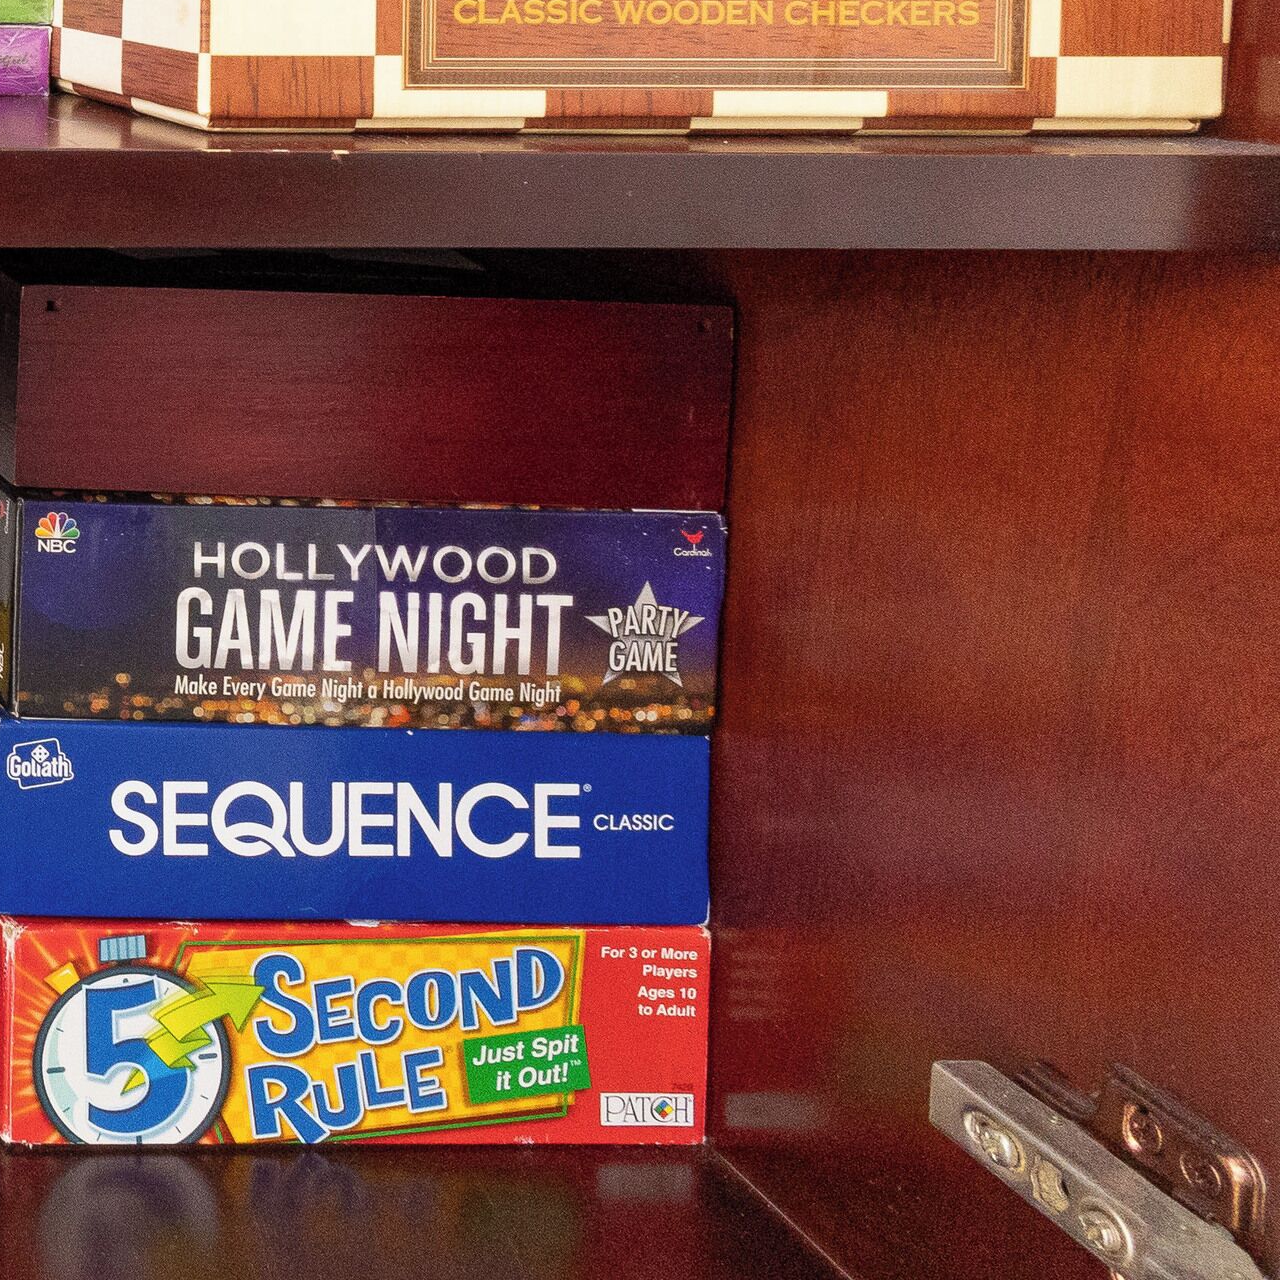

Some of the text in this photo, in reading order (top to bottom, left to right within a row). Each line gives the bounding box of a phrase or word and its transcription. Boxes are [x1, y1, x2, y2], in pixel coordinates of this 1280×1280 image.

[453, 0, 980, 27] CLASSIC WOODEN CHECKERS
[37, 539, 77, 554] NBC
[193, 541, 559, 586] HOLLYWOOD
[175, 586, 574, 676] GAME NIGHT
[174, 675, 562, 706] Make Every Game Night a Hollywood Game Night
[108, 780, 674, 860] SEQUENCE CLASSIC
[252, 946, 566, 1057] SECOND
[245, 1048, 445, 1144] RULE
